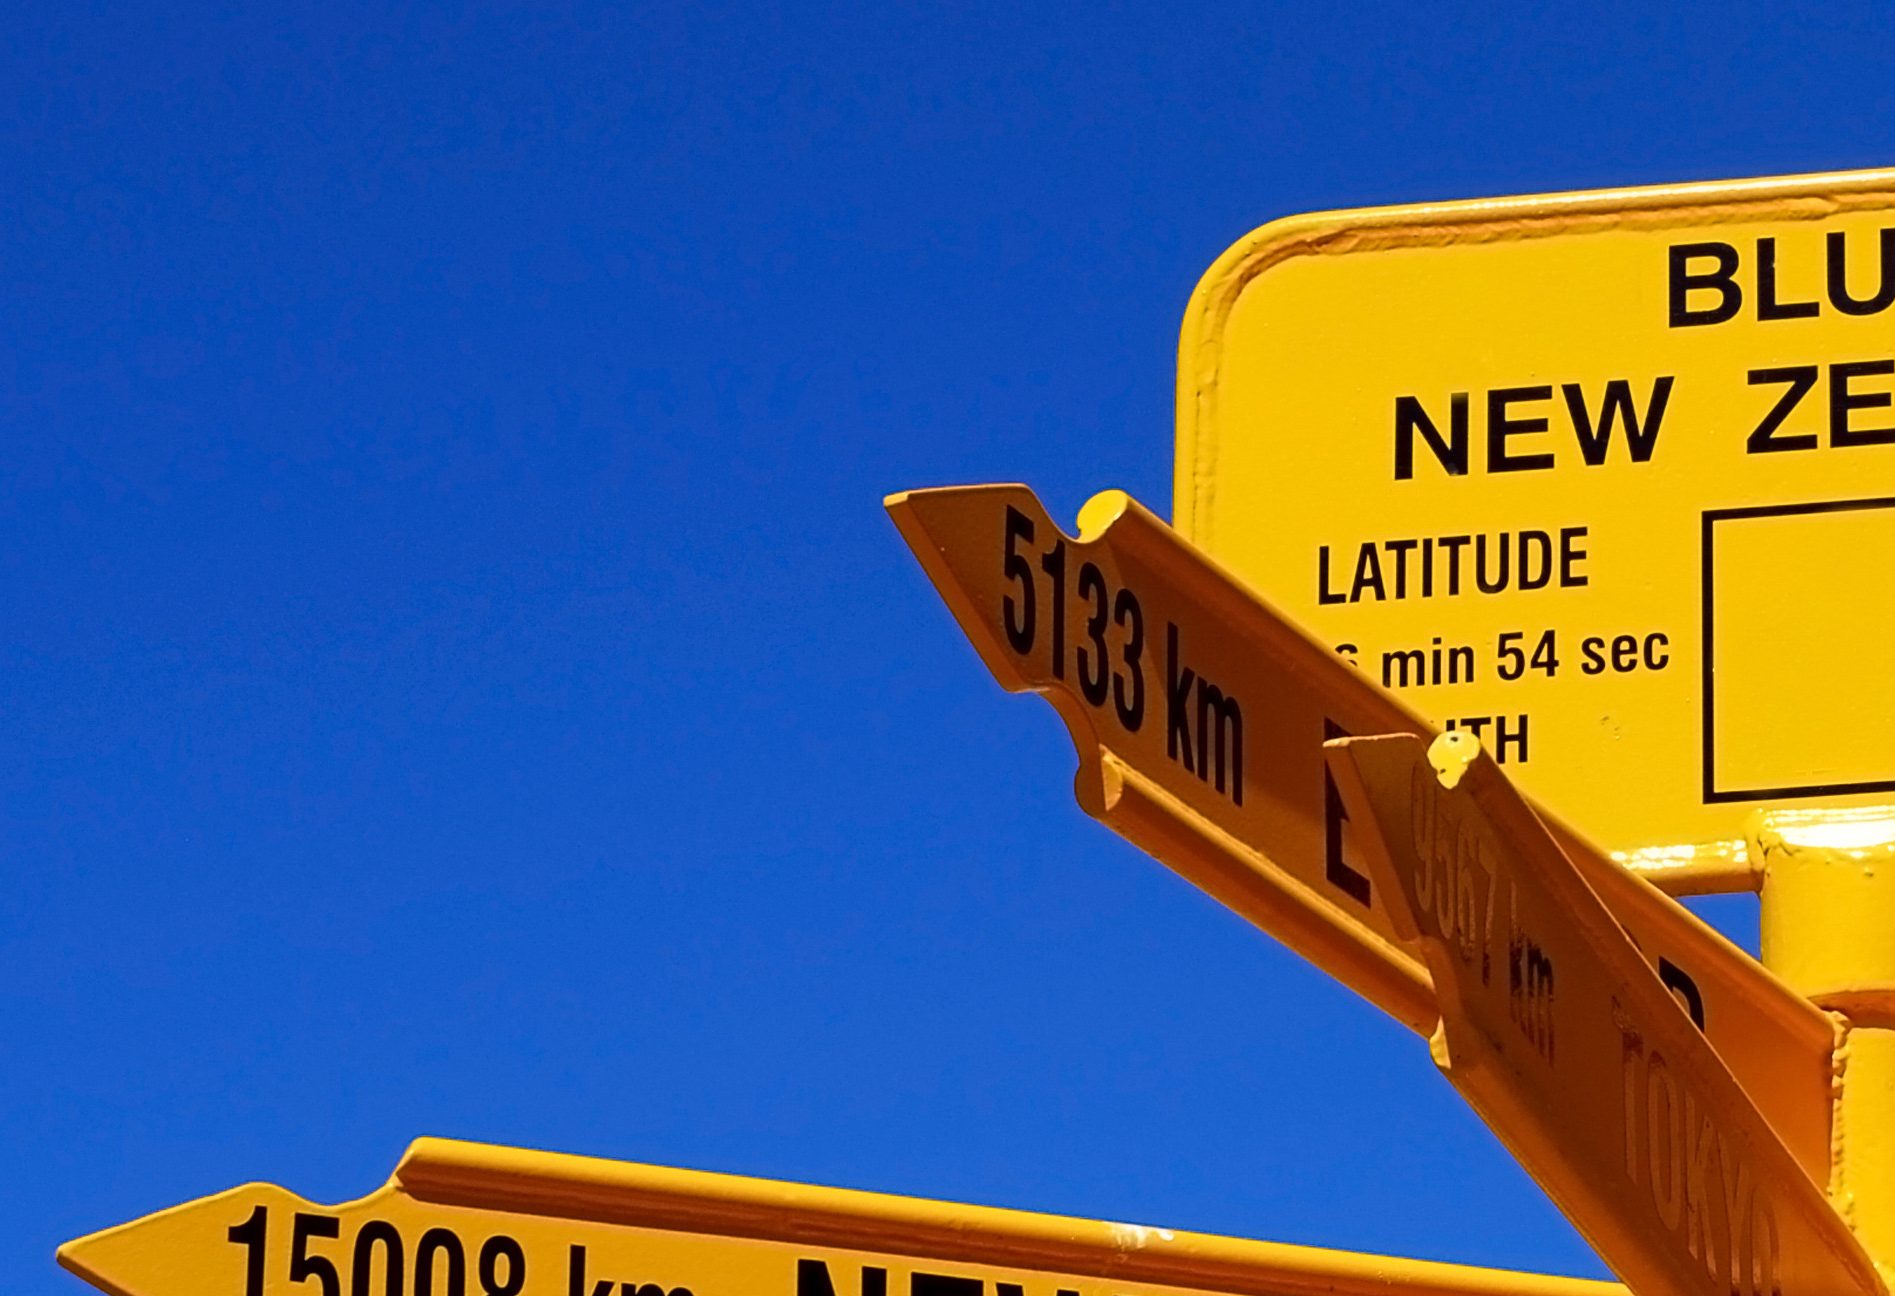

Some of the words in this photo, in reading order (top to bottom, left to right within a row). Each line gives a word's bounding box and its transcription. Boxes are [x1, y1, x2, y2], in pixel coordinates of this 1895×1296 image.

[1394, 376, 1675, 480] NEW
[1318, 526, 1590, 605] LATITUDE
[1003, 503, 1145, 734] 5133
[1167, 622, 1243, 808] km
[1382, 637, 1474, 688] min
[1496, 629, 1560, 681] 54
[1581, 630, 1670, 675] sec
